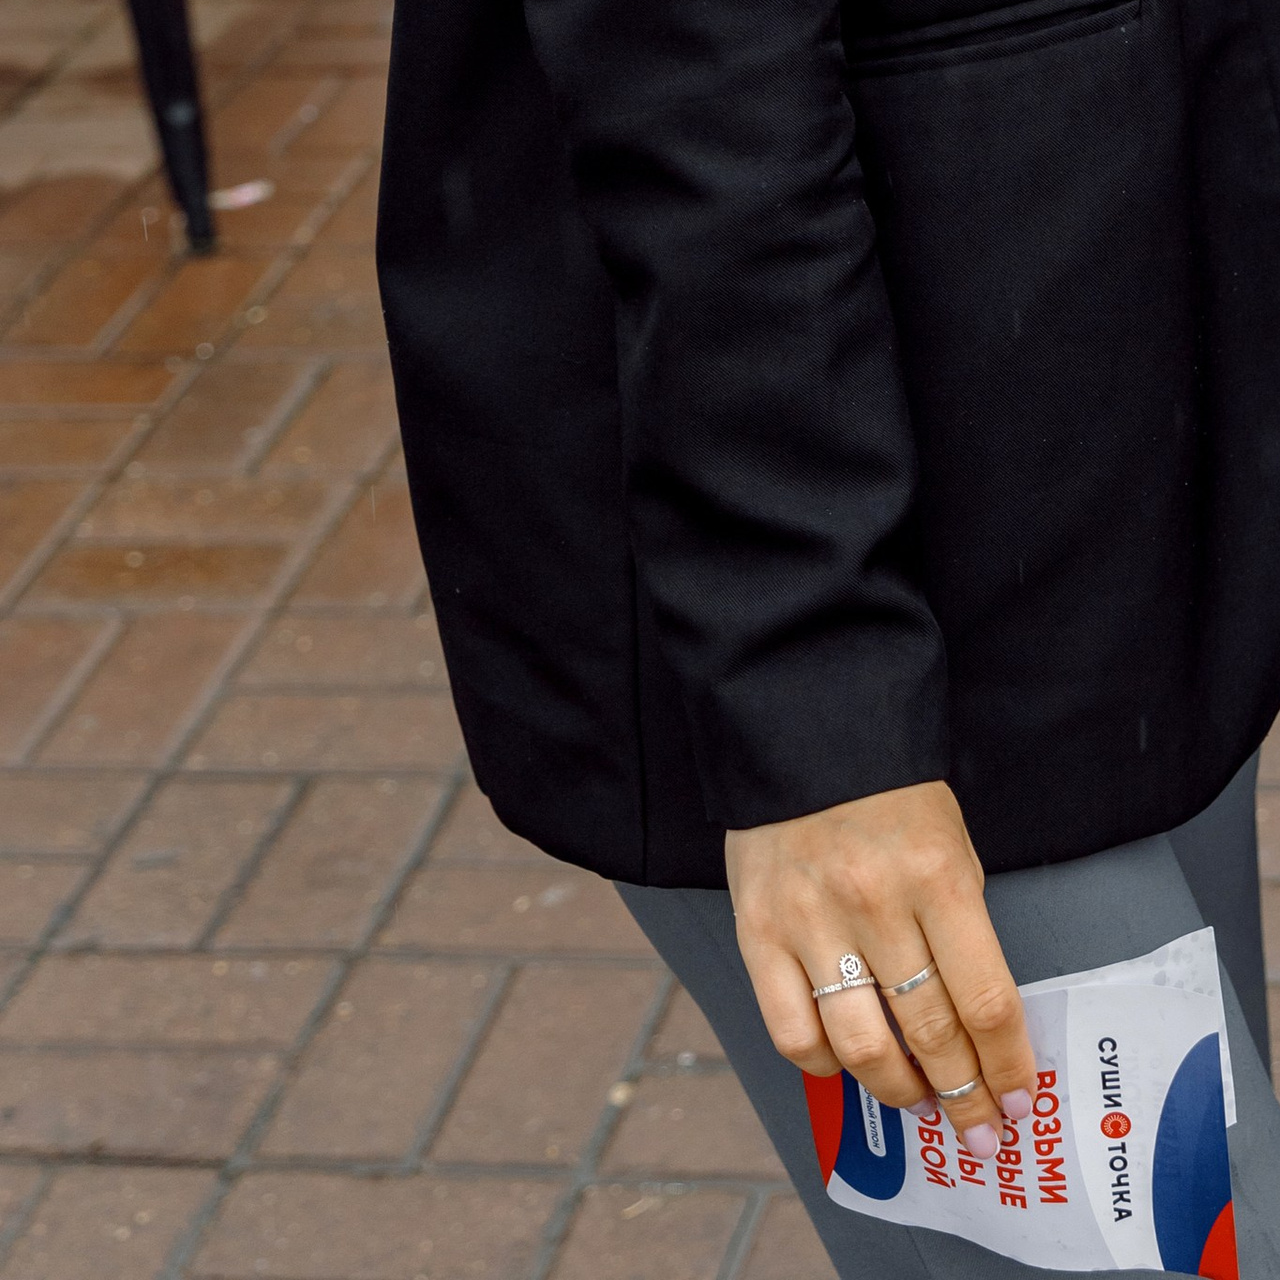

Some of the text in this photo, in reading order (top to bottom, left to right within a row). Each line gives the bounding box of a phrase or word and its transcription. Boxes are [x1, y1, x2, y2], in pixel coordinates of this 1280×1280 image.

[918, 1110, 956, 1188] ОБОЙ
[1032, 1070, 1068, 1204] ВОЗЬМИ
[1098, 1037, 1132, 1222] СУШИ ТОЧКА
